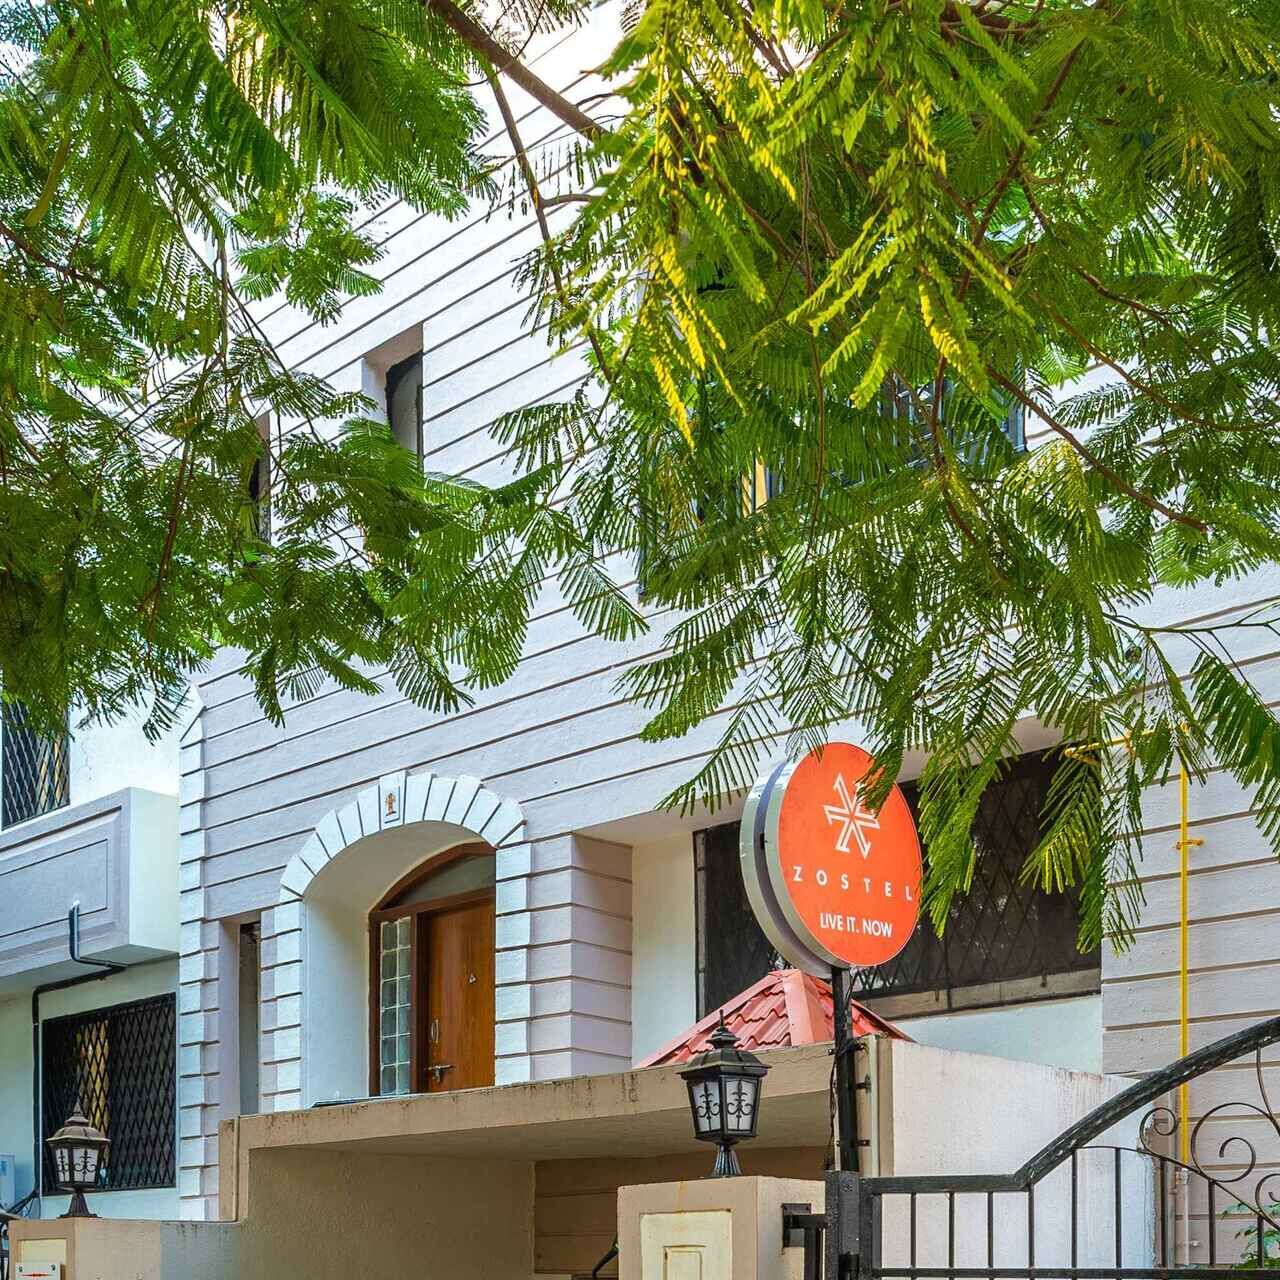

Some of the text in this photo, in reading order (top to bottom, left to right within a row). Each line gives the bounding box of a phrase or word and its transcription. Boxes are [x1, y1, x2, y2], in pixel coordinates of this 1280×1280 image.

[793, 866, 913, 901] ZOSTEL
[819, 912, 893, 938] LIVE IT. NOW
